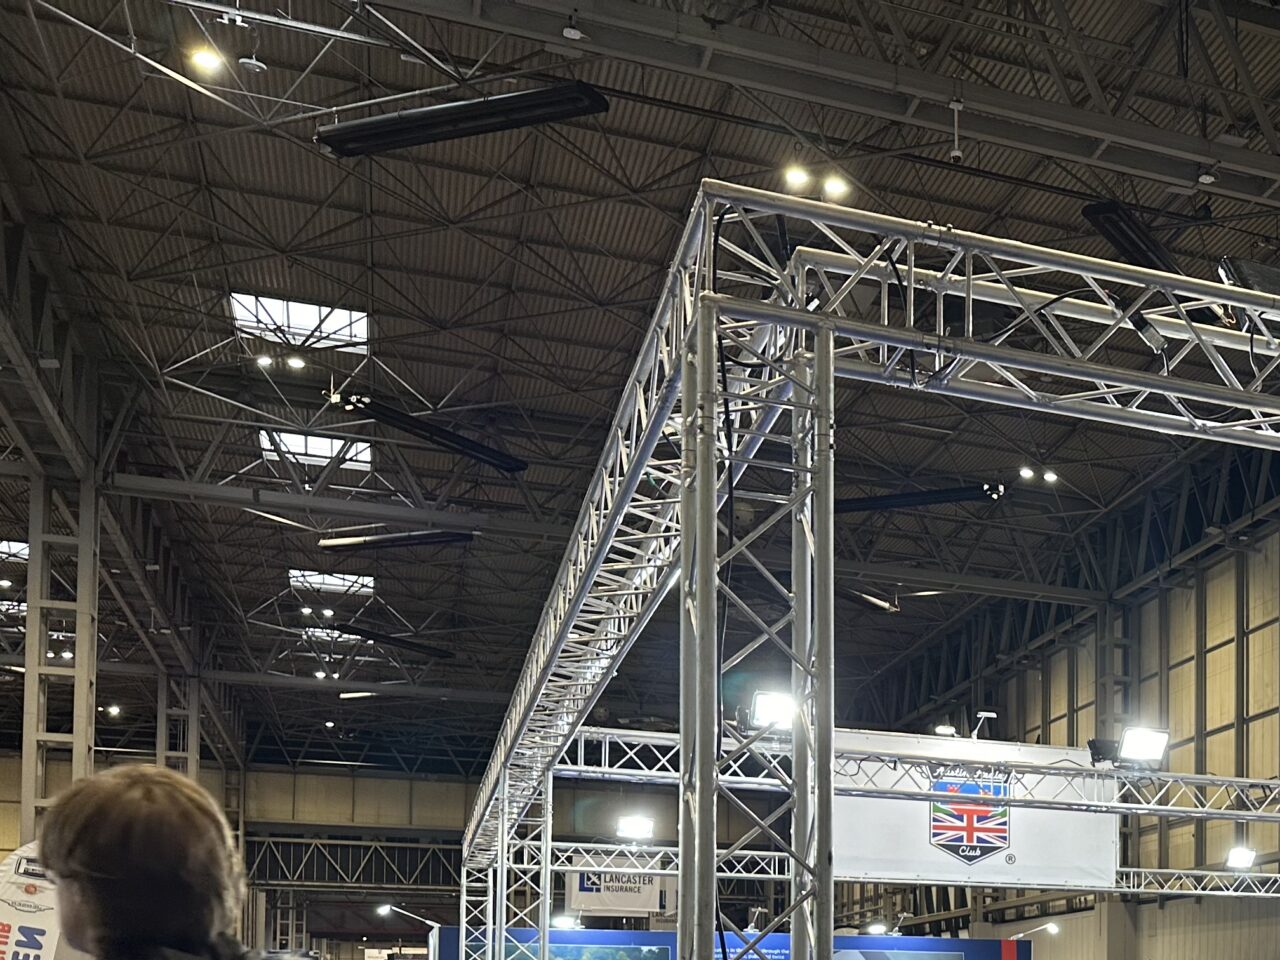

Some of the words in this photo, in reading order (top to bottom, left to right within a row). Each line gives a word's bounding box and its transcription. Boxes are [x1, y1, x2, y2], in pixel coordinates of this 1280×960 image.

[959, 846, 981, 856] Club
[604, 873, 654, 886] LANCASTER
[604, 885, 642, 894] INSURANCE
